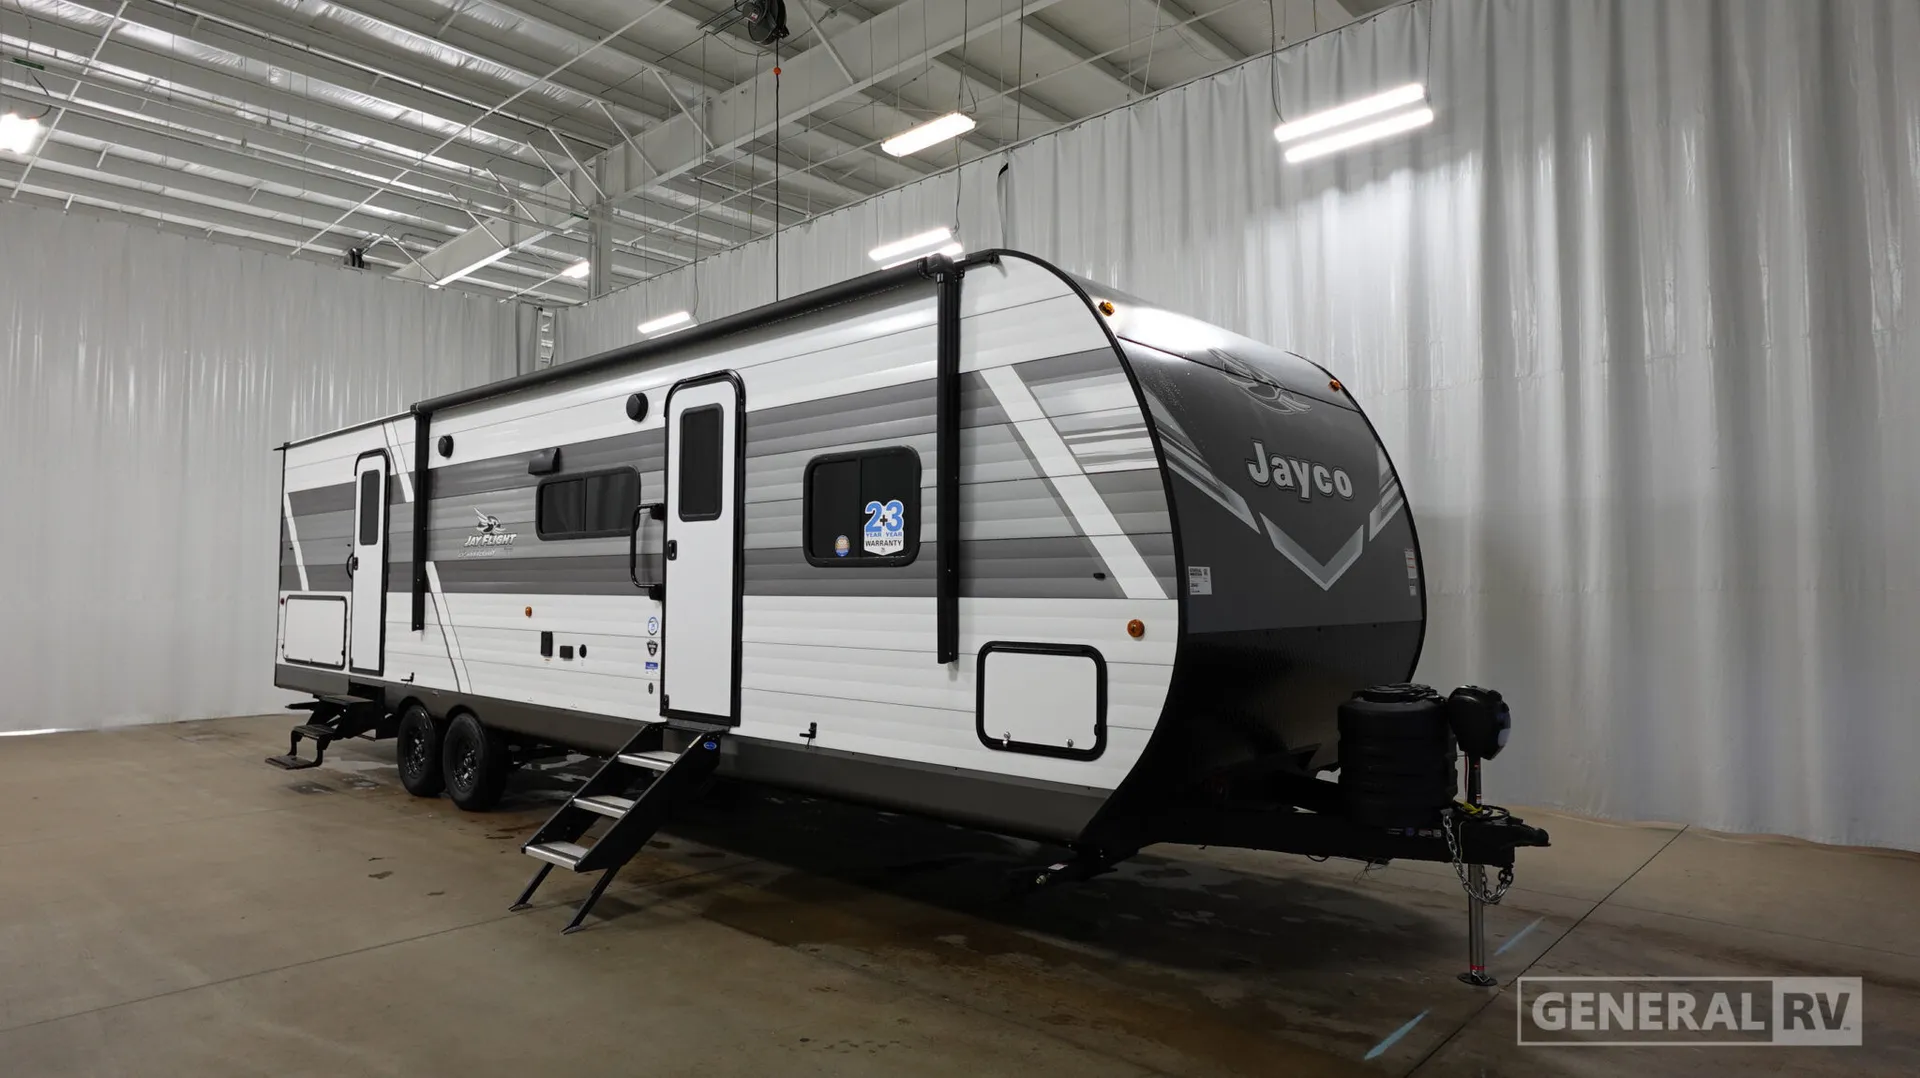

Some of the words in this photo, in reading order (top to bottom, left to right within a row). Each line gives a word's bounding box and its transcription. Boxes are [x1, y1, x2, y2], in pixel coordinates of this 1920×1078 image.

[1246, 440, 1354, 501] Jayco
[464, 535, 482, 547] JAY
[481, 534, 517, 546] FLIGHT
